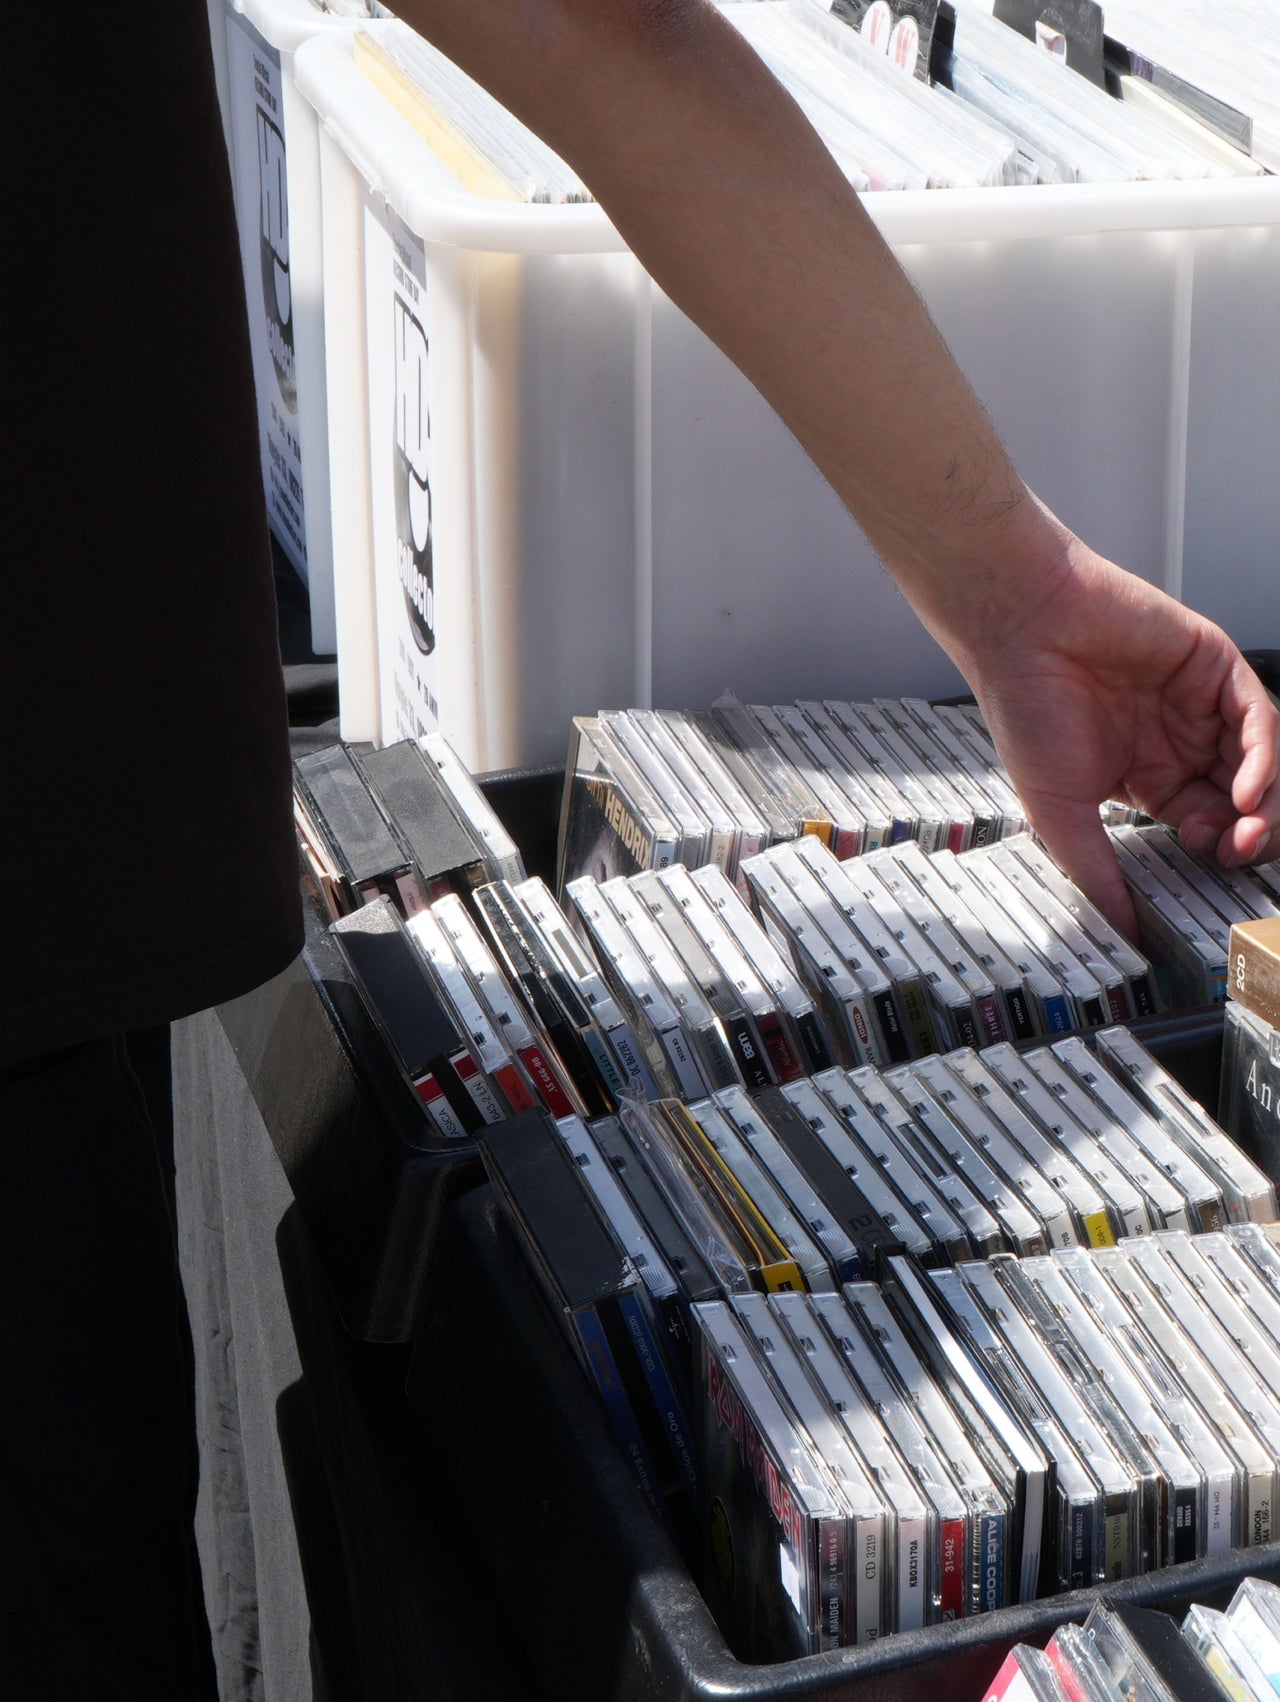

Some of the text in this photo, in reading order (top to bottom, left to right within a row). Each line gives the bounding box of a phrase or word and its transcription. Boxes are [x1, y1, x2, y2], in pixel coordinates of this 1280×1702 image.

[603, 789, 651, 872] HENDRIX
[1236, 953, 1246, 992] 2CD
[854, 1012, 866, 1038] DINDI
[984, 1005, 999, 1037] THREE
[1012, 997, 1023, 1026] VERTIGO
[737, 1032, 756, 1060] wea
[599, 1053, 620, 1084] LITTLE
[667, 1410, 679, 1432] Oro
[1254, 1509, 1262, 1546] LONDON
[1261, 1499, 1270, 1526] 166-2
[865, 1534, 876, 1581] CD 3219
[944, 1538, 955, 1573] 31-942
[987, 1518, 998, 1567] ALICE
[909, 1539, 919, 1588] KBOX3170A
[829, 1596, 841, 1630] MAIDEN
